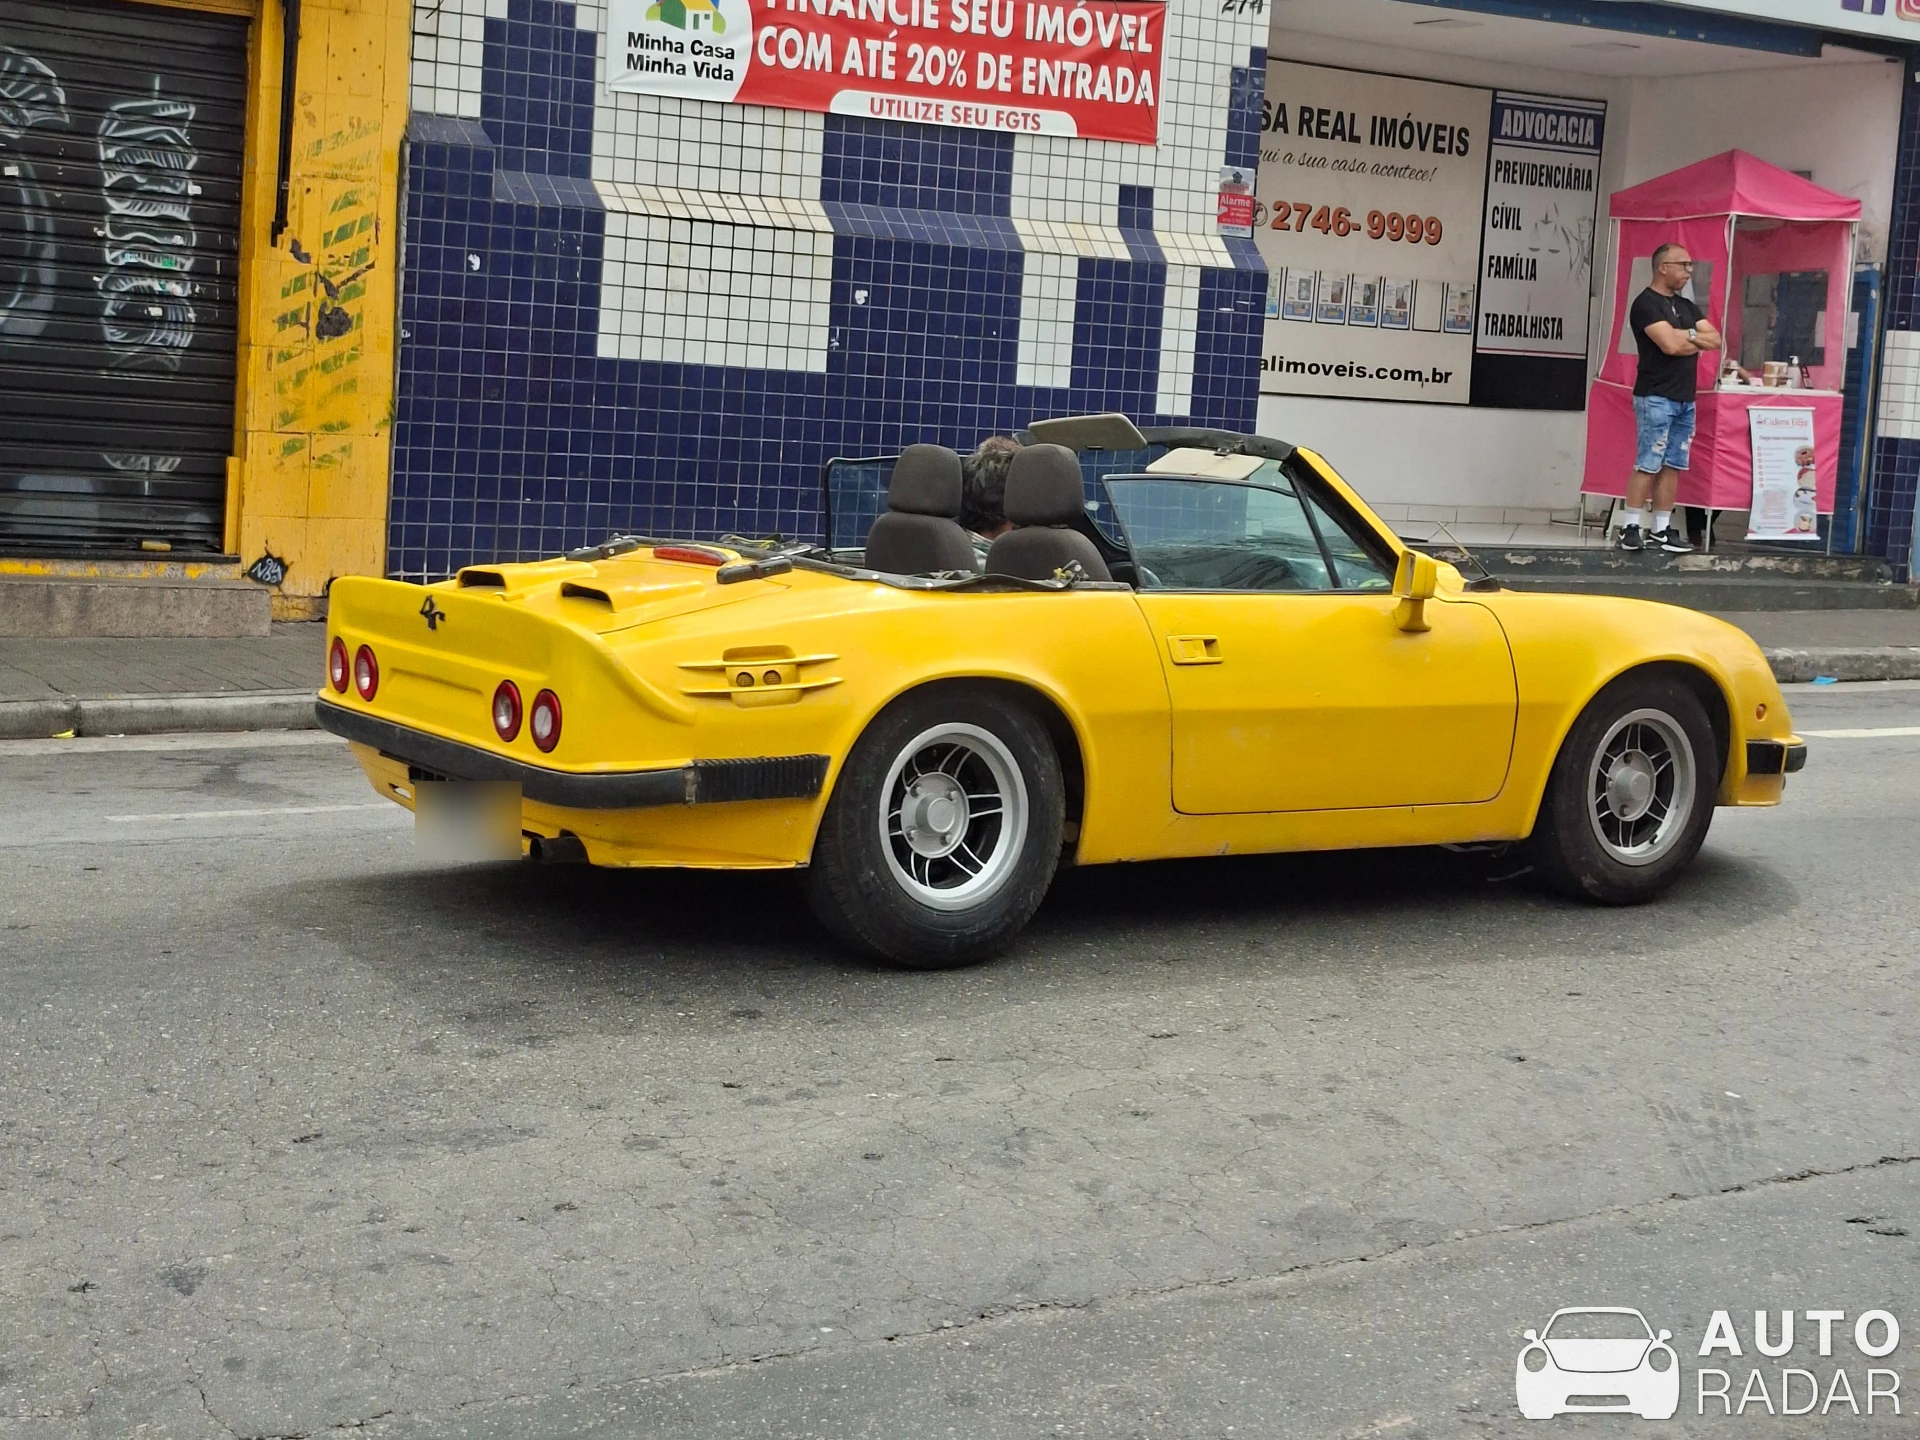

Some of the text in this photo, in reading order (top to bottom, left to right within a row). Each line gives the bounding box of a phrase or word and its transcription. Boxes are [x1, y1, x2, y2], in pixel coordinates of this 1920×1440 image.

[950, 0, 1014, 38] SEU
[1025, 0, 1152, 53] IMÓVEL
[627, 32, 735, 60] Minha Casa
[626, 53, 734, 82] Minha Vida
[758, 26, 1155, 107] COM ATÉ 20% DE ENTRADA
[870, 97, 1041, 131] UTILIZE SEU FGTS
[1500, 108, 1595, 146] ADVOCACIA
[1298, 105, 1361, 144] REAL
[1370, 113, 1470, 157] IMÓVEIS
[1283, 152, 1295, 164] a
[1298, 152, 1328, 169] sua
[1331, 157, 1367, 174] casa
[1370, 164, 1438, 183] acontece!
[1494, 159, 1592, 192] PREVIDENCIÁRIA
[1220, 195, 1251, 208] Alarme
[1491, 202, 1522, 231] CÍVIL
[1487, 252, 1537, 282] FAMÍLIA
[1484, 313, 1563, 341] TRABALHISTA
[1259, 355, 1453, 384] alimoveis.com.br
